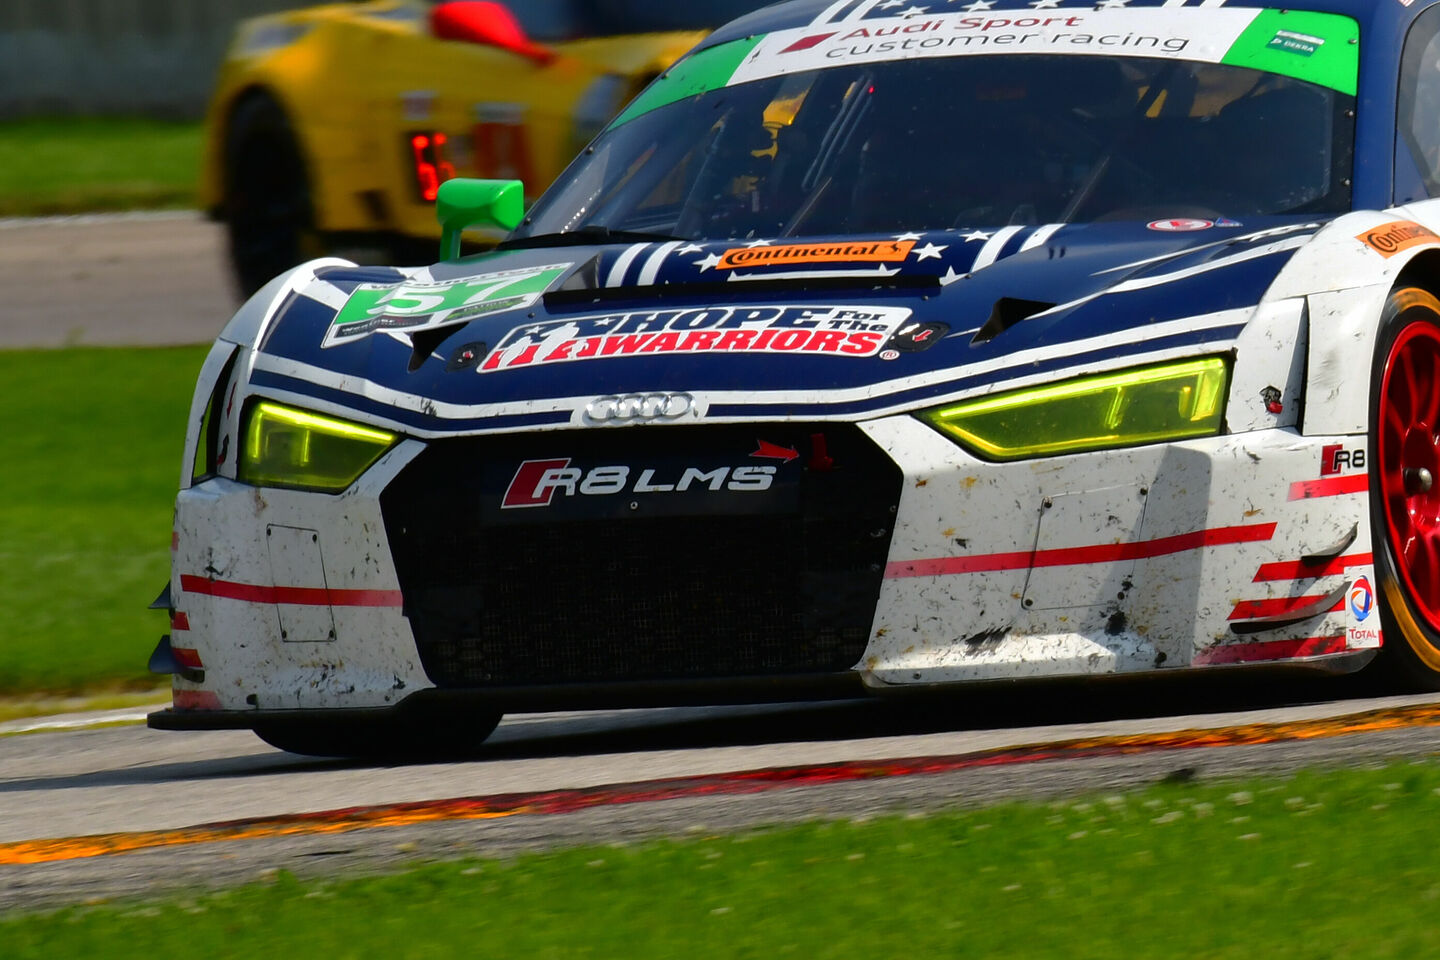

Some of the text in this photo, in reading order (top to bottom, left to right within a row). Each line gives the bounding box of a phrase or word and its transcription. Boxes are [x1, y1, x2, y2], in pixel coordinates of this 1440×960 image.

[839, 15, 1084, 41] Audi Sport
[825, 29, 1190, 58] customer racing
[725, 243, 880, 266] Continental
[366, 268, 545, 316] 57
[619, 306, 889, 333] HOPE For The
[604, 330, 884, 356] WARRIORS
[1333, 448, 1366, 471] R8
[531, 464, 778, 499] R8 LMS
